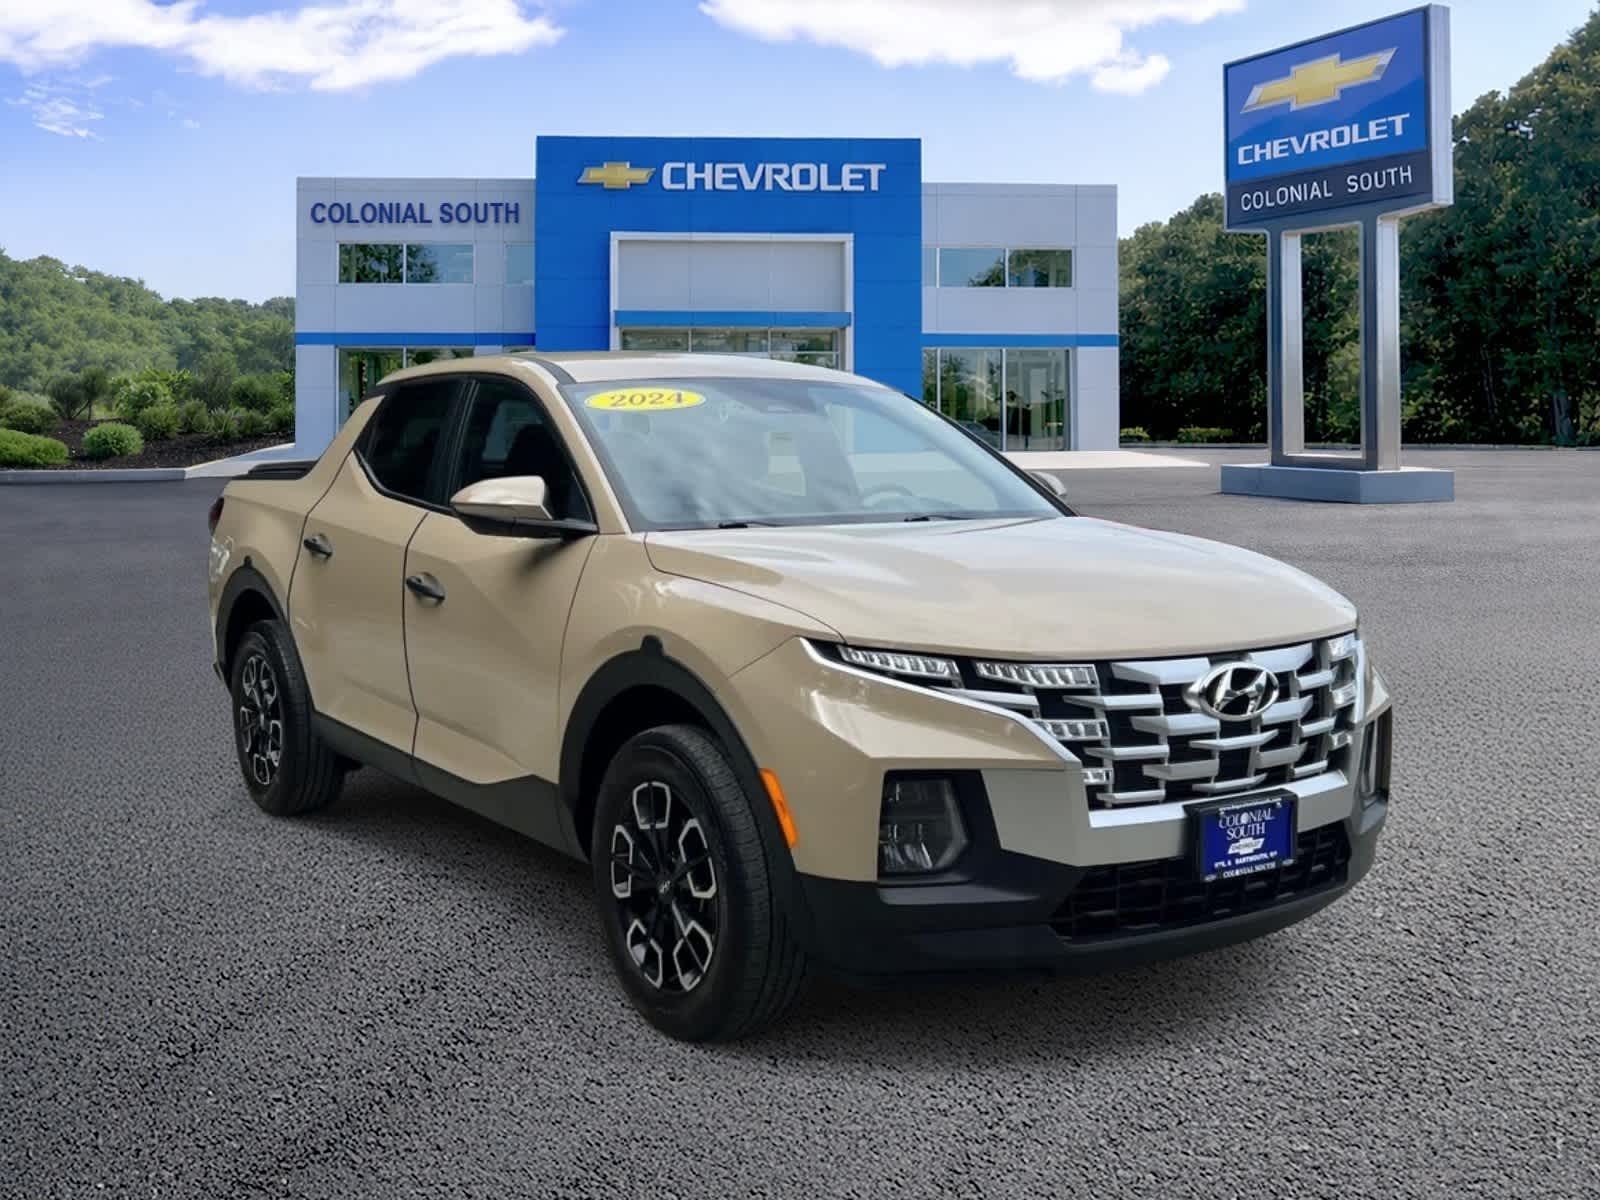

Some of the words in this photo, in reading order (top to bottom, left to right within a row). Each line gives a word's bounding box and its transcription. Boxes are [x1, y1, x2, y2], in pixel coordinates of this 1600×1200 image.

[1237, 113, 1410, 165] CHEVROLET
[662, 162, 887, 191] CHEVROLET
[1241, 179, 1333, 211] COLONIAL
[1346, 165, 1413, 193] SOUTH
[310, 202, 433, 224] COLONIAL
[439, 202, 520, 224] SOUTH
[610, 392, 682, 407] 2024
[1219, 808, 1274, 829] COLONIAL
[1226, 822, 1266, 840] SOUTH
